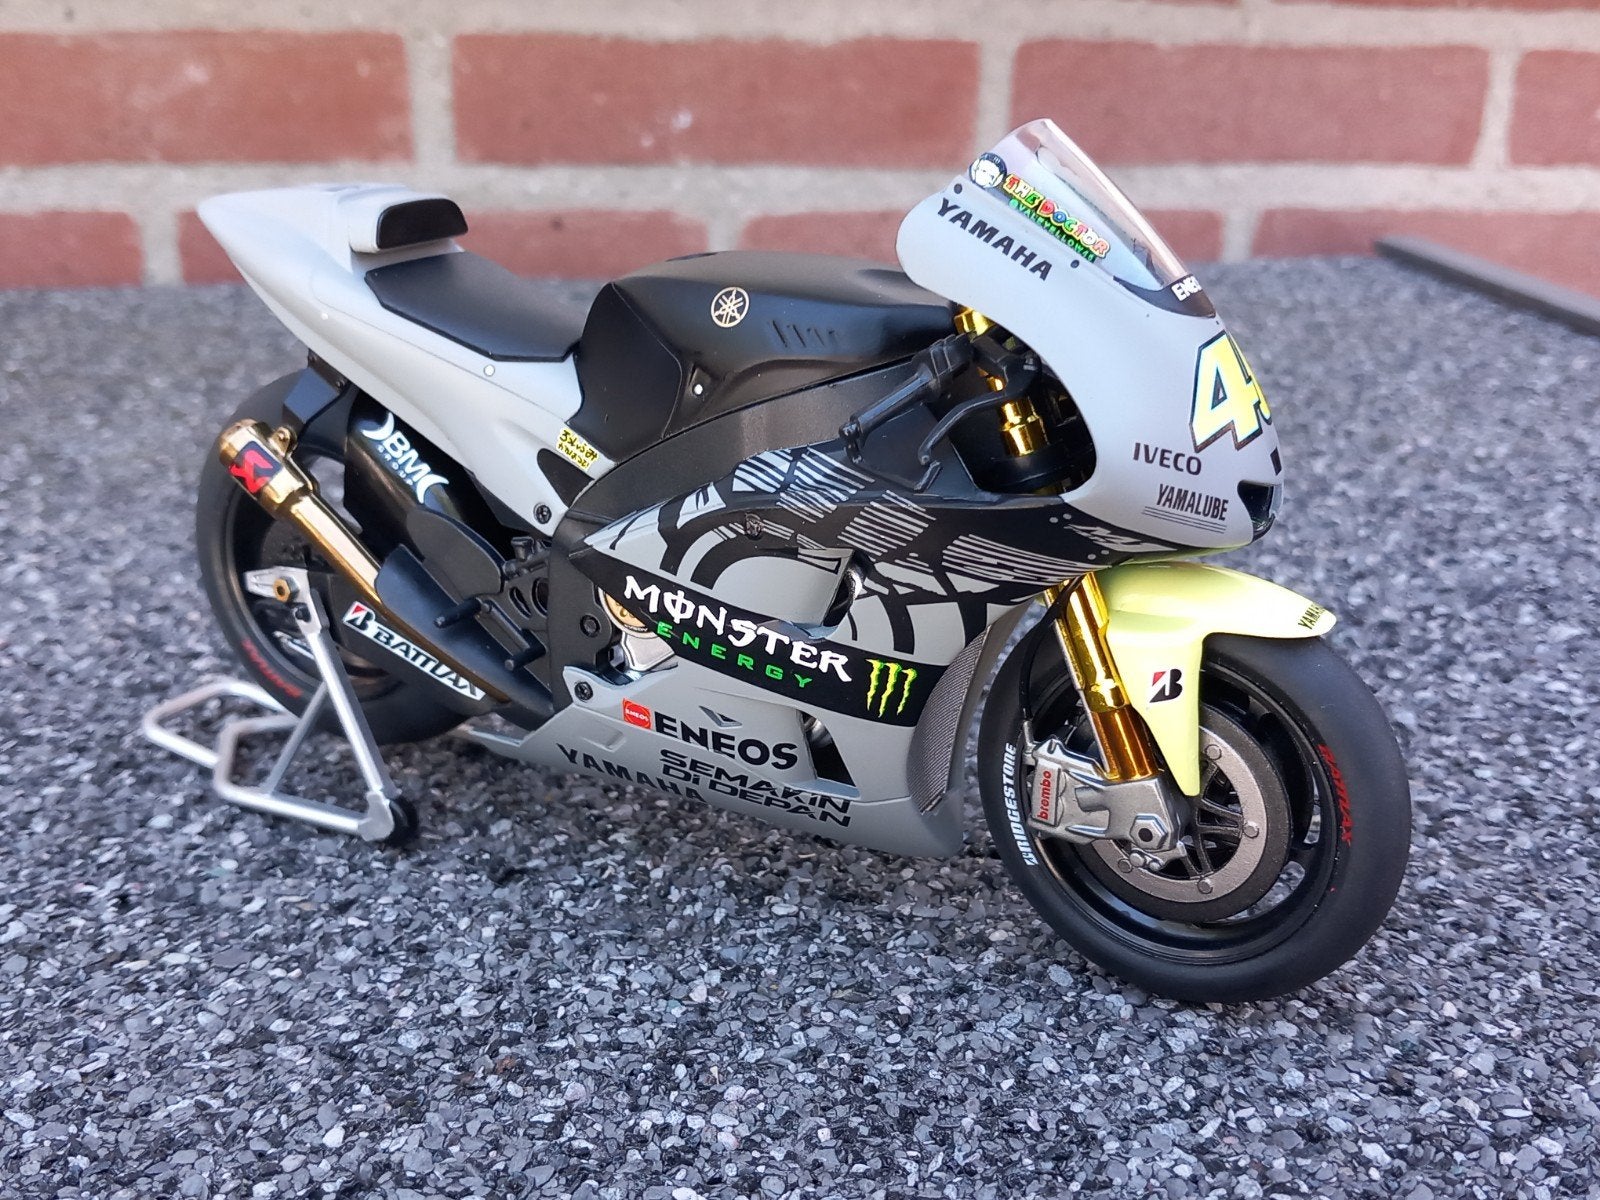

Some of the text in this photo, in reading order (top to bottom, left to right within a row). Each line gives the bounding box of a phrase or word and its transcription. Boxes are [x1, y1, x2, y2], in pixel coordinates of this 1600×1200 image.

[937, 197, 1053, 281] YAMAHA
[1002, 173, 1110, 260] THE DOCTOR
[1189, 329, 1273, 454] 4
[1133, 441, 1203, 476] IVECO
[1156, 482, 1230, 521] YAMALUBE
[656, 620, 813, 689] ENERGY
[653, 710, 799, 771] ENEOS
[555, 742, 707, 803] YAMAHA
[1036, 769, 1052, 820] brembo
[708, 779, 852, 829] DEPAN
[1002, 742, 1039, 867] BRIDGESTONE
